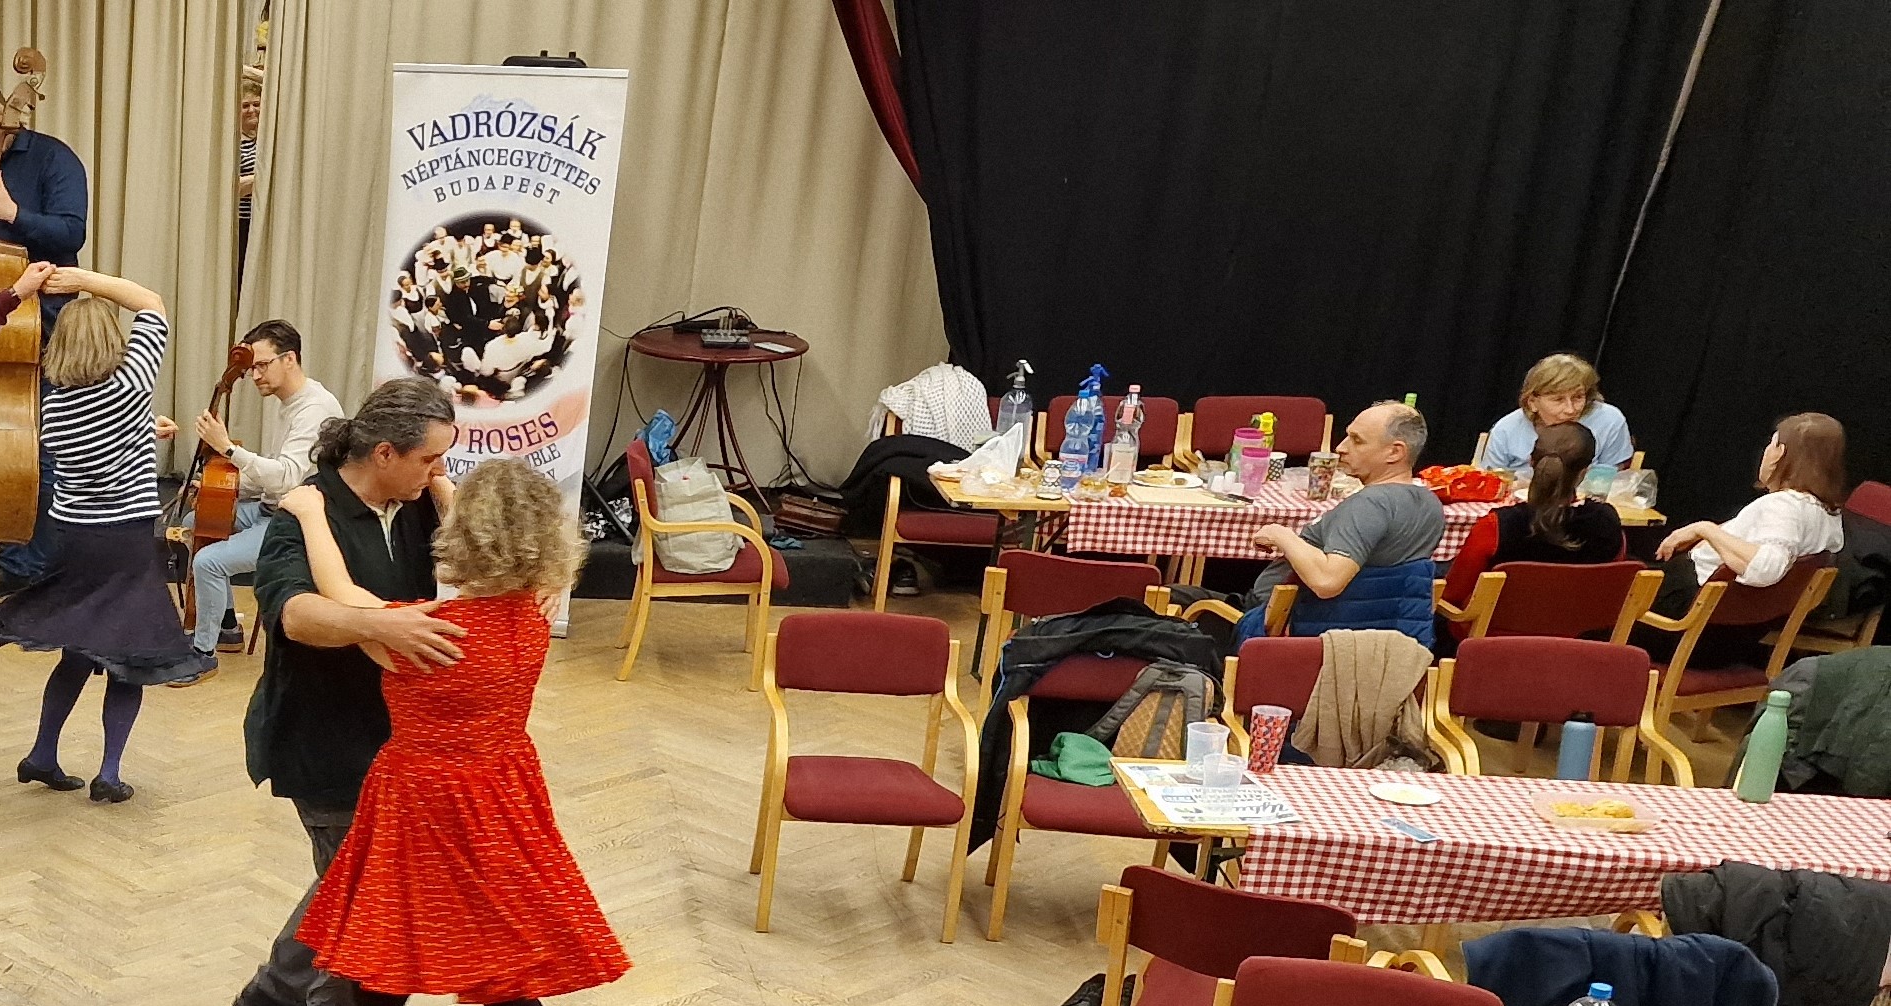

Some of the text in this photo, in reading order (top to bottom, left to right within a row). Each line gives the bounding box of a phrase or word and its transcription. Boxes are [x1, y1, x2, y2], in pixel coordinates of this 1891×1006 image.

[406, 102, 607, 160] VADRÓZSÁK
[400, 147, 601, 196] NÉPTÁNCEGYÜTTES
[433, 174, 561, 205] BUDAPEST
[466, 412, 559, 454] ROSES
